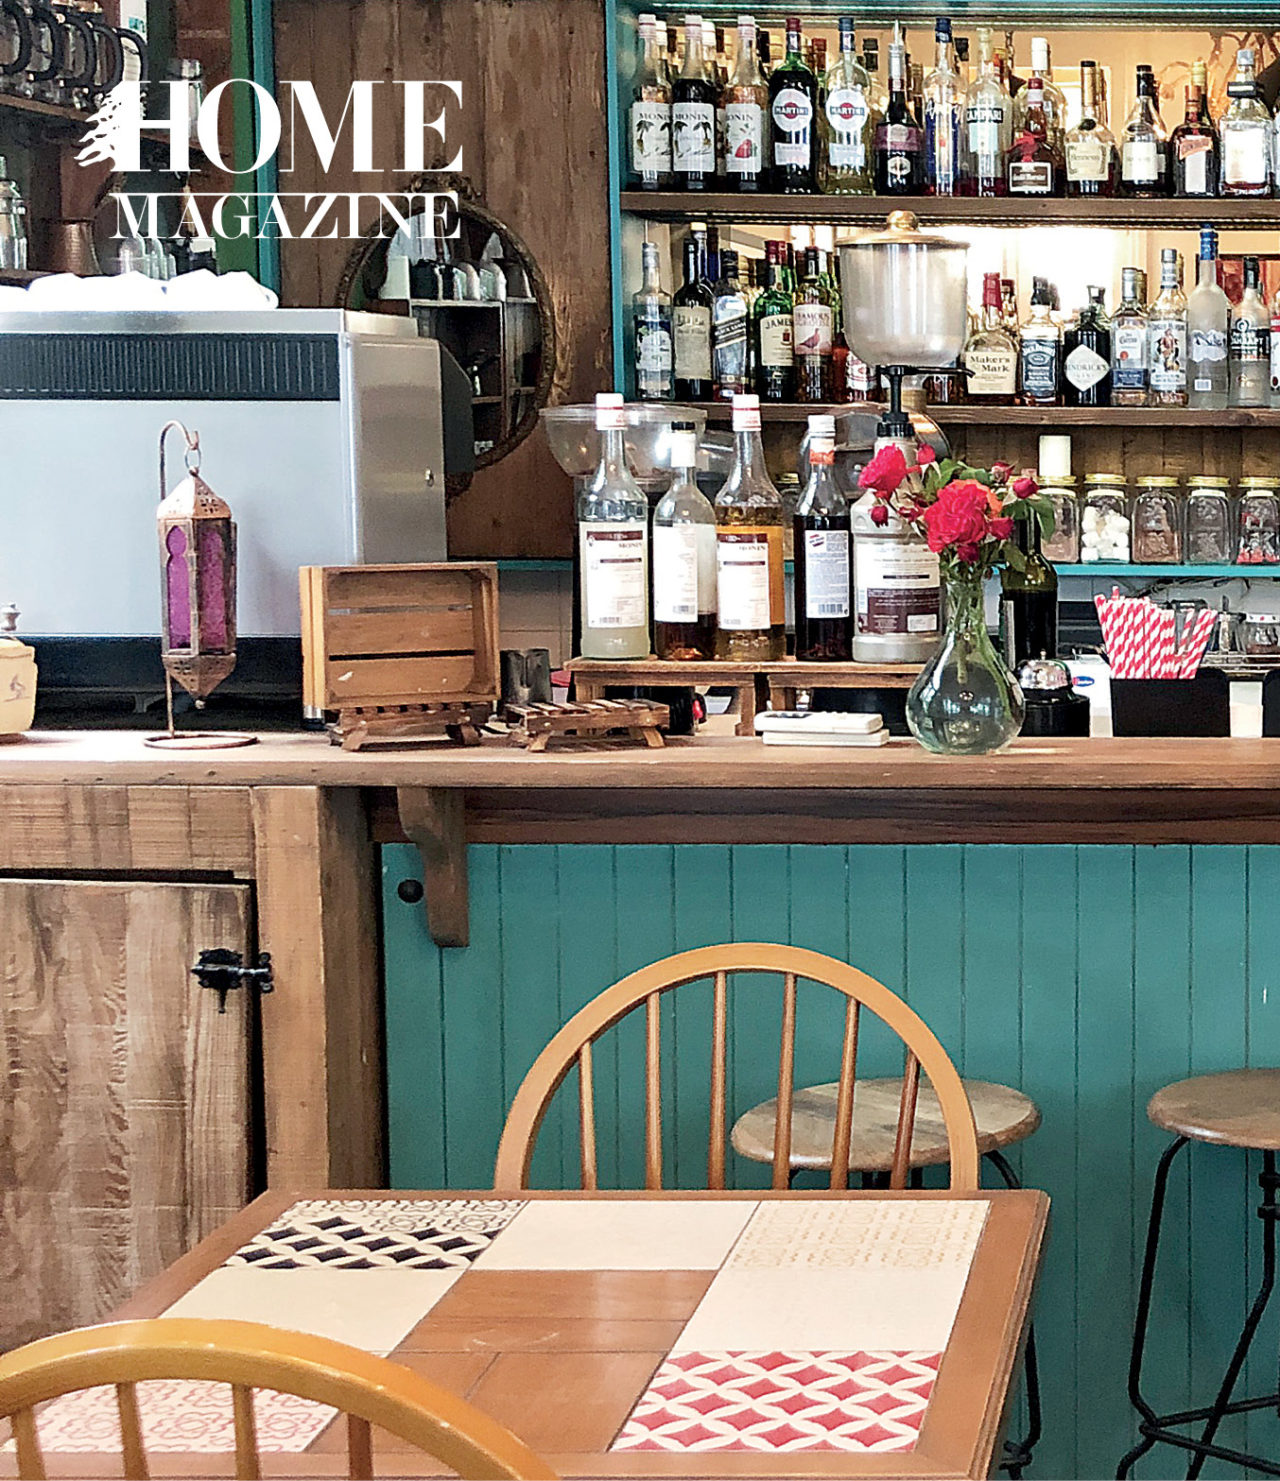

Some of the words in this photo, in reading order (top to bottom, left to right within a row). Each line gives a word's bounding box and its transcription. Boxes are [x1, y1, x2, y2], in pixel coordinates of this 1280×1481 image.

[775, 106, 808, 115] MARTINI
[831, 106, 864, 115] MARTINI
[675, 112, 708, 120] MONIN
[726, 113, 753, 121] ONIN
[981, 364, 1010, 372] Mark
